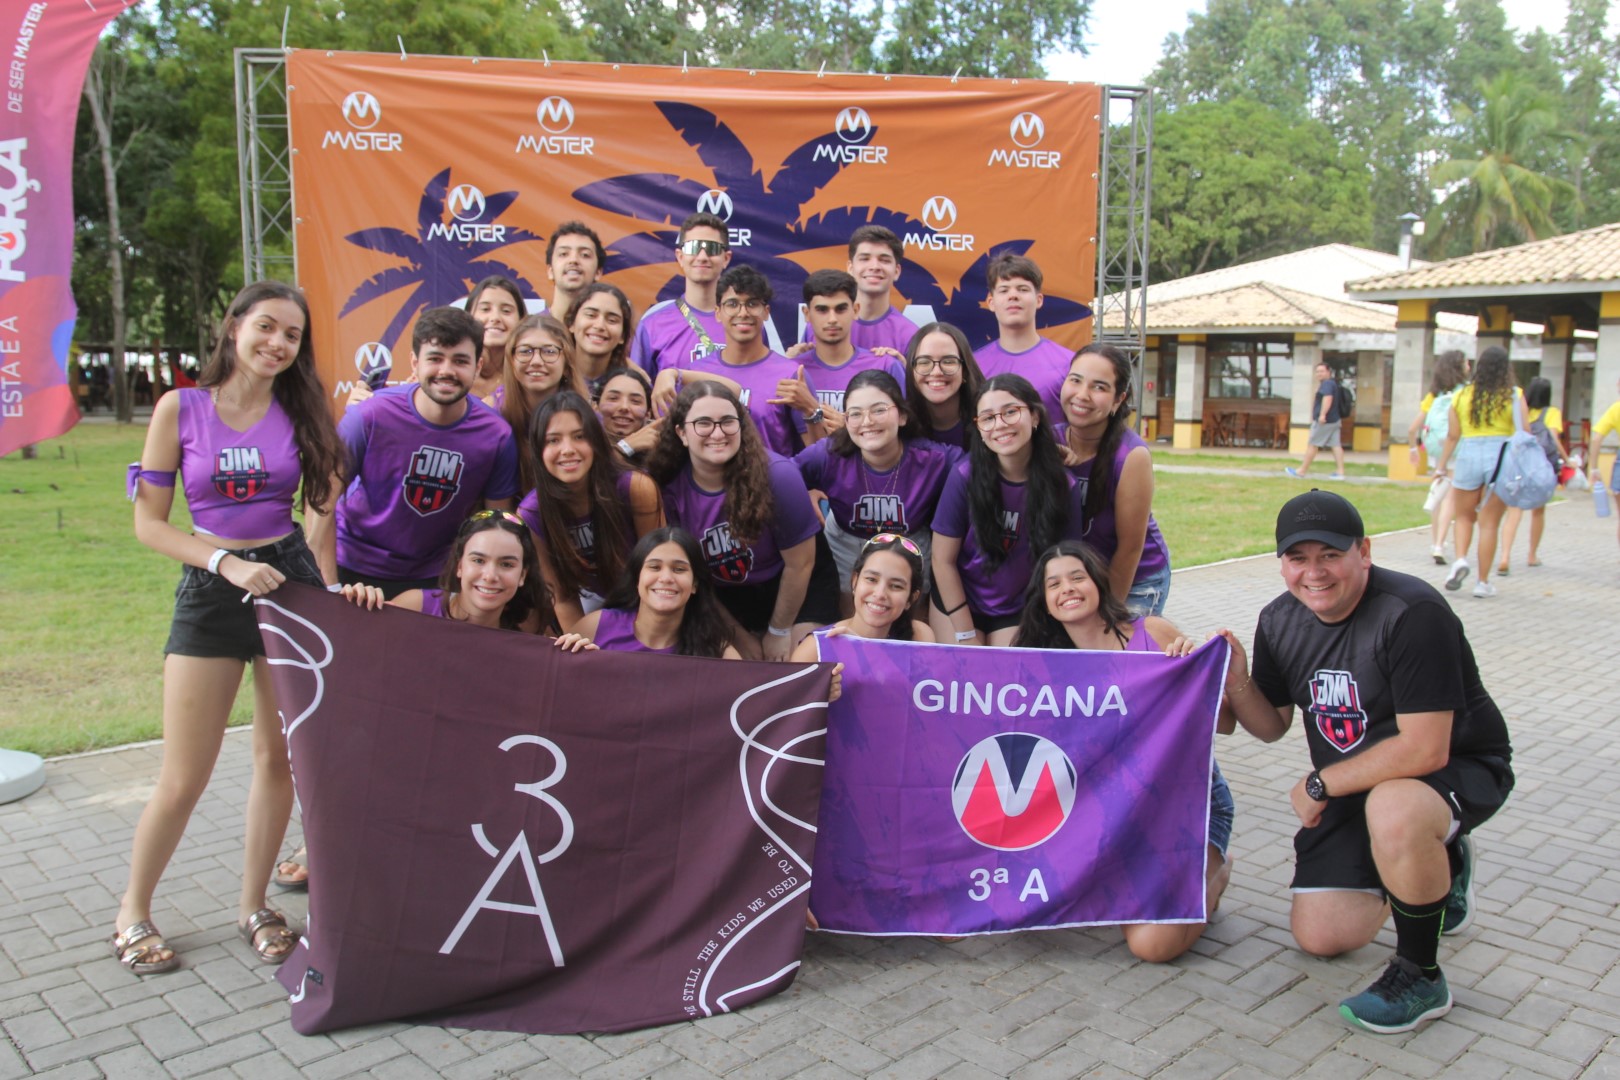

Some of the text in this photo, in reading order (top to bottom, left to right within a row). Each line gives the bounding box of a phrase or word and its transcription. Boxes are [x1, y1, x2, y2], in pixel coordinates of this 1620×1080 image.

[7, 1, 48, 113] DE SER MASTER.
[321, 130, 402, 152] MASTER
[515, 134, 595, 155] MASTER
[812, 144, 888, 164] MASTER
[987, 149, 1061, 169] MASTER
[426, 222, 506, 243] MASTER
[902, 232, 975, 252] MASTER
[0, 315, 19, 333] A
[1, 361, 23, 417] ESTA
[219, 447, 261, 471] JIM
[415, 448, 460, 481] JIM
[860, 497, 898, 522] JIM
[912, 679, 1128, 718] GINCANA
[1316, 673, 1353, 706] JIM
[761, 842, 779, 858] BE
[777, 859, 794, 875] TO
[767, 876, 798, 899] USED
[968, 867, 1050, 903] 3ª A
[747, 897, 766, 913] WE
[717, 912, 747, 939] KIDS
[697, 939, 719, 962] THE
[682, 967, 701, 1002] STILL
